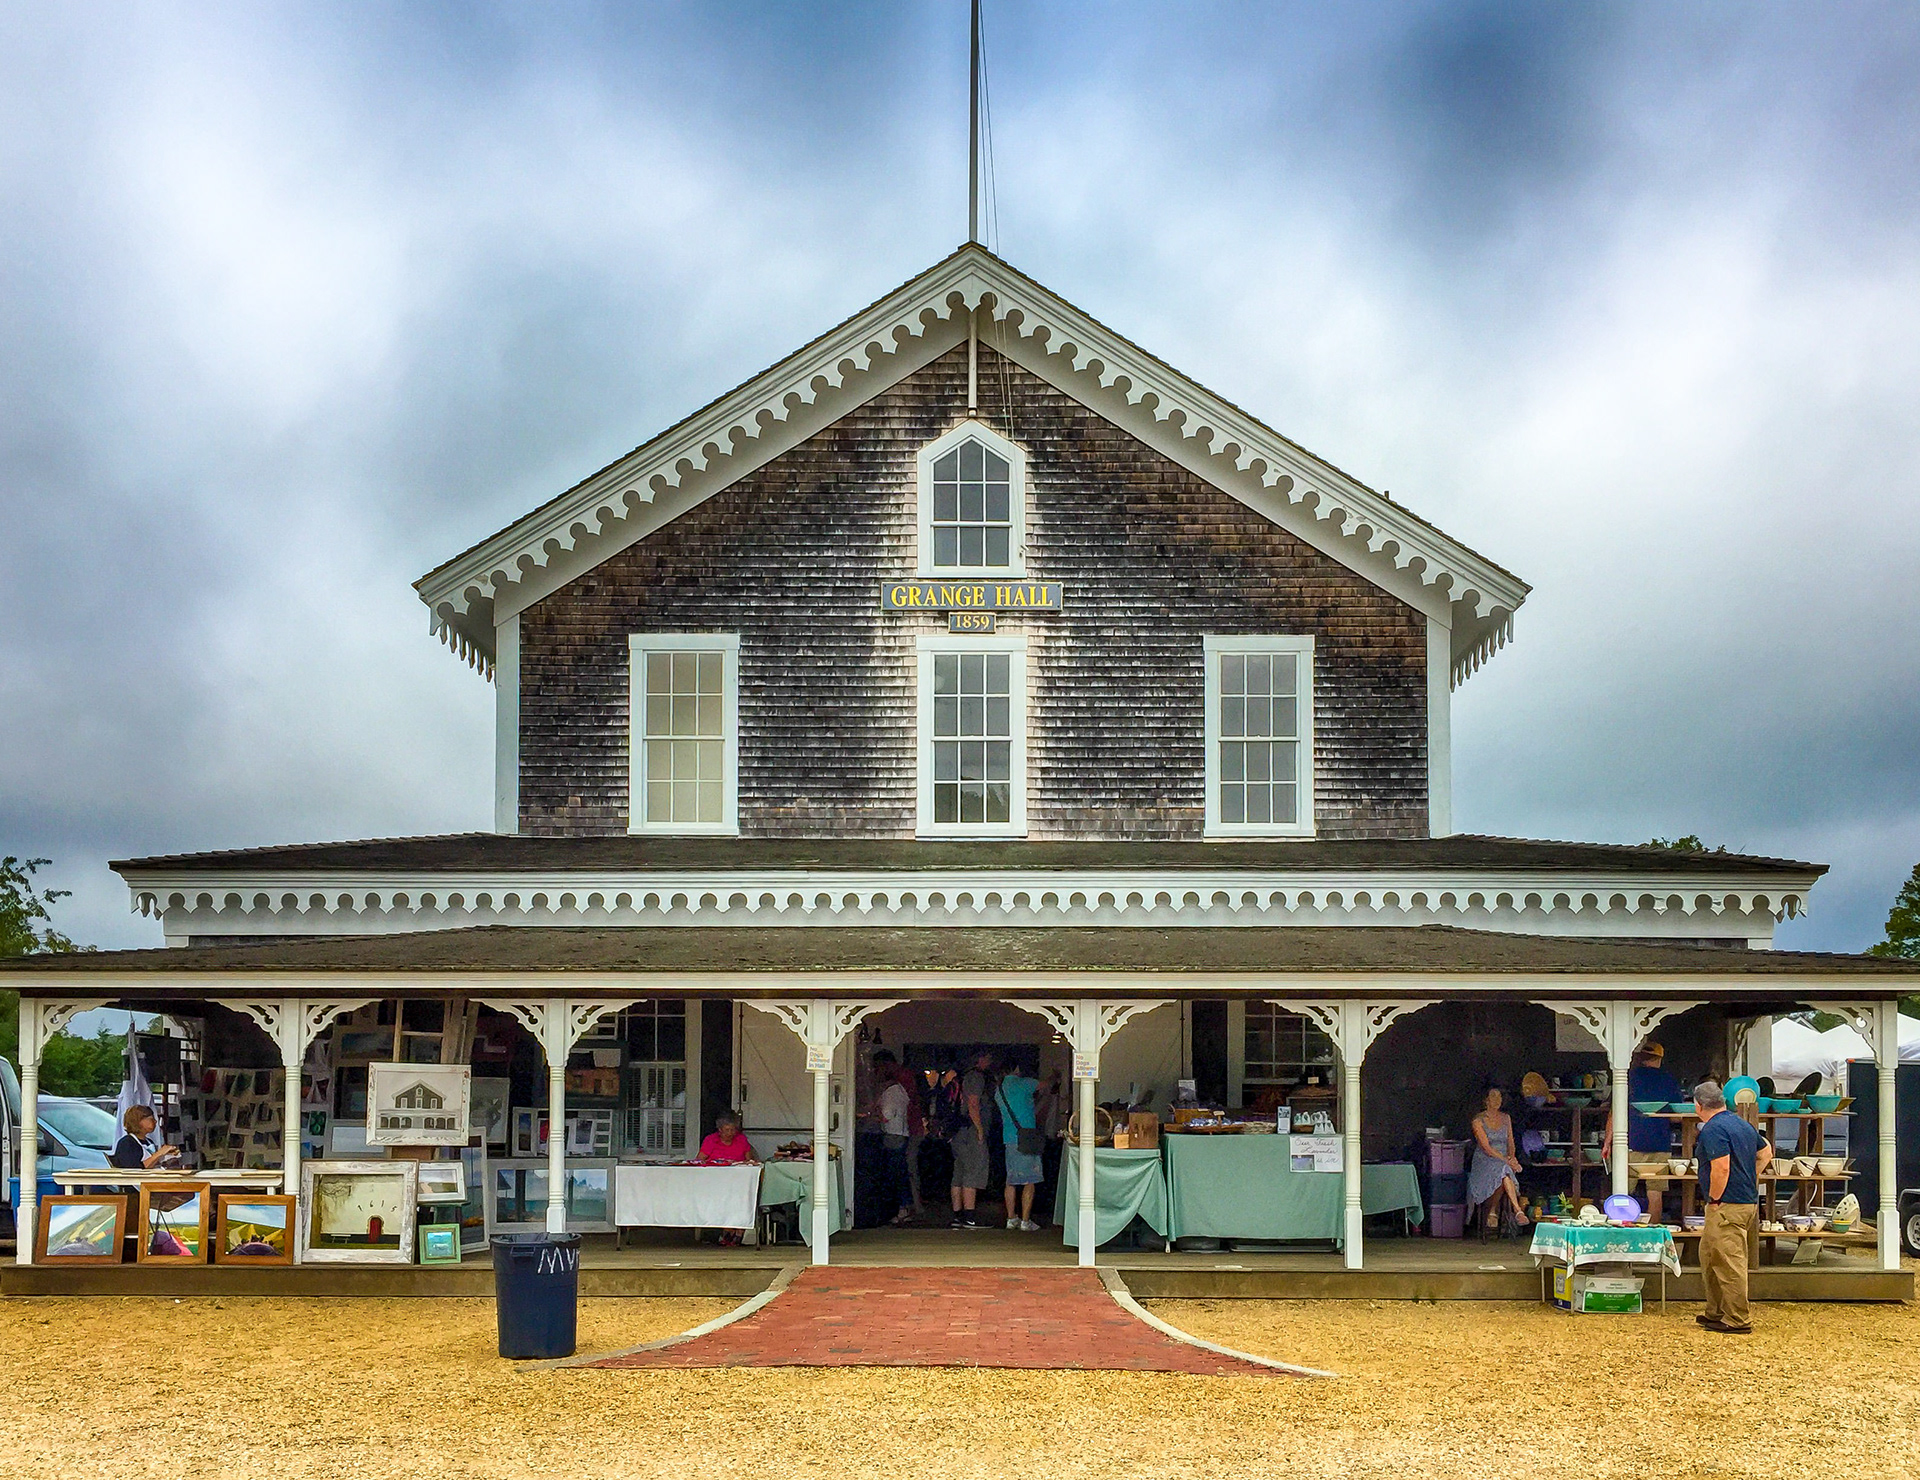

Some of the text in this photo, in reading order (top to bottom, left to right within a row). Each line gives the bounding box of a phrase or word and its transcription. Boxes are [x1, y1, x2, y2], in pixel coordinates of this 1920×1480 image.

[891, 586, 1053, 607] GRANGE HALL
[955, 615, 990, 630] 1859
